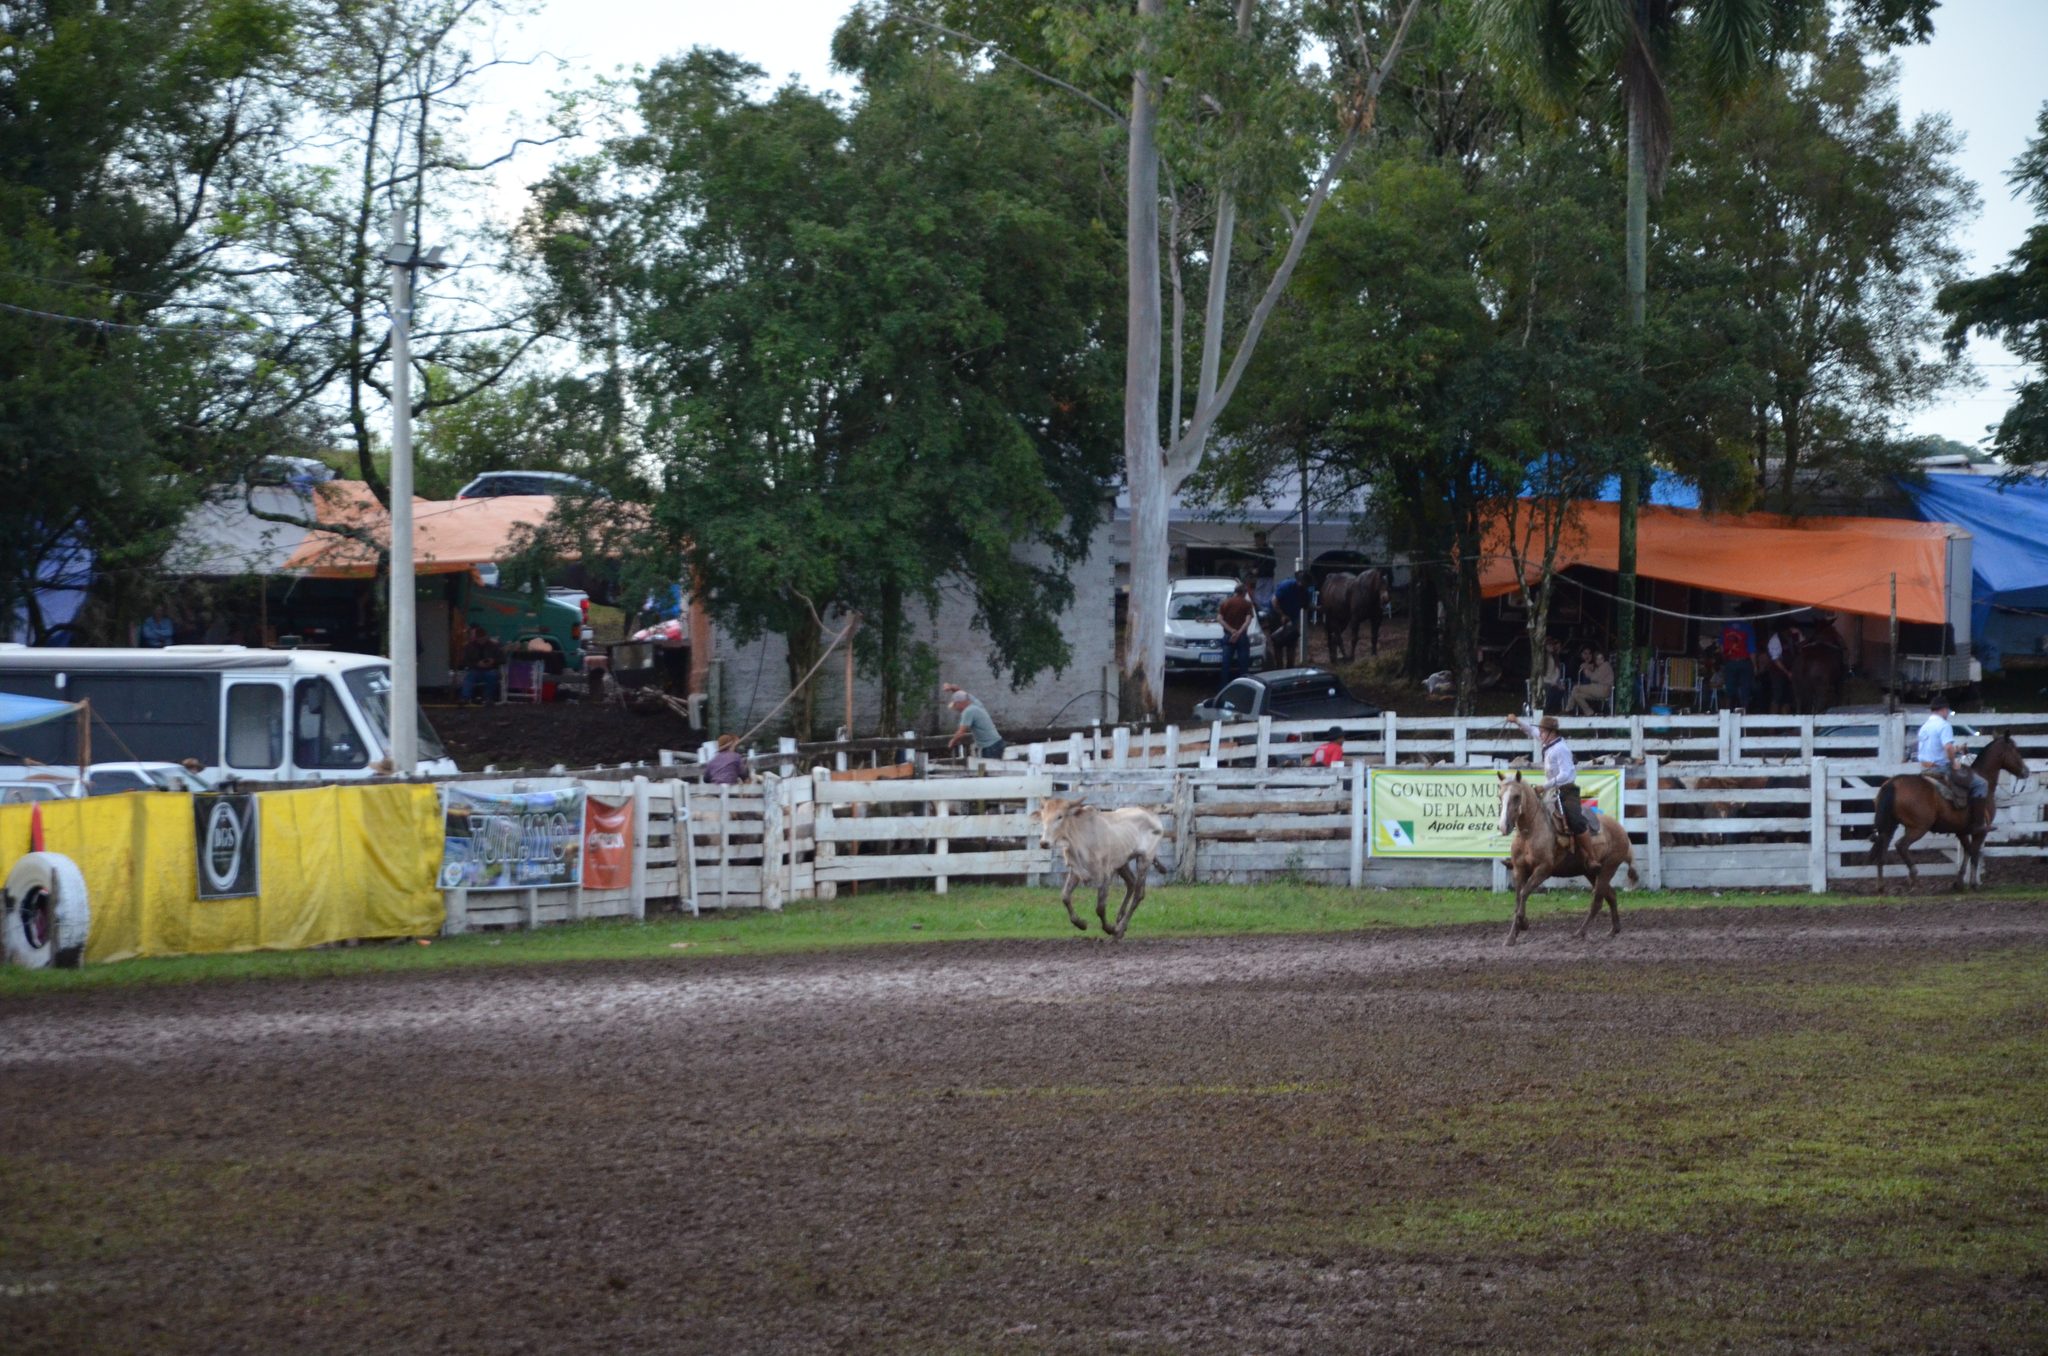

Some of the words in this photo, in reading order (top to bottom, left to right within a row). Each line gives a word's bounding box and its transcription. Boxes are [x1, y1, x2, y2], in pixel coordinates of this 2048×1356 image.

[1391, 783, 1467, 798] GOVERNO
[1423, 803, 1442, 817] DE
[1428, 820, 1465, 833] Apoia
[1468, 820, 1494, 831] este
[468, 812, 568, 864] TURISMO
